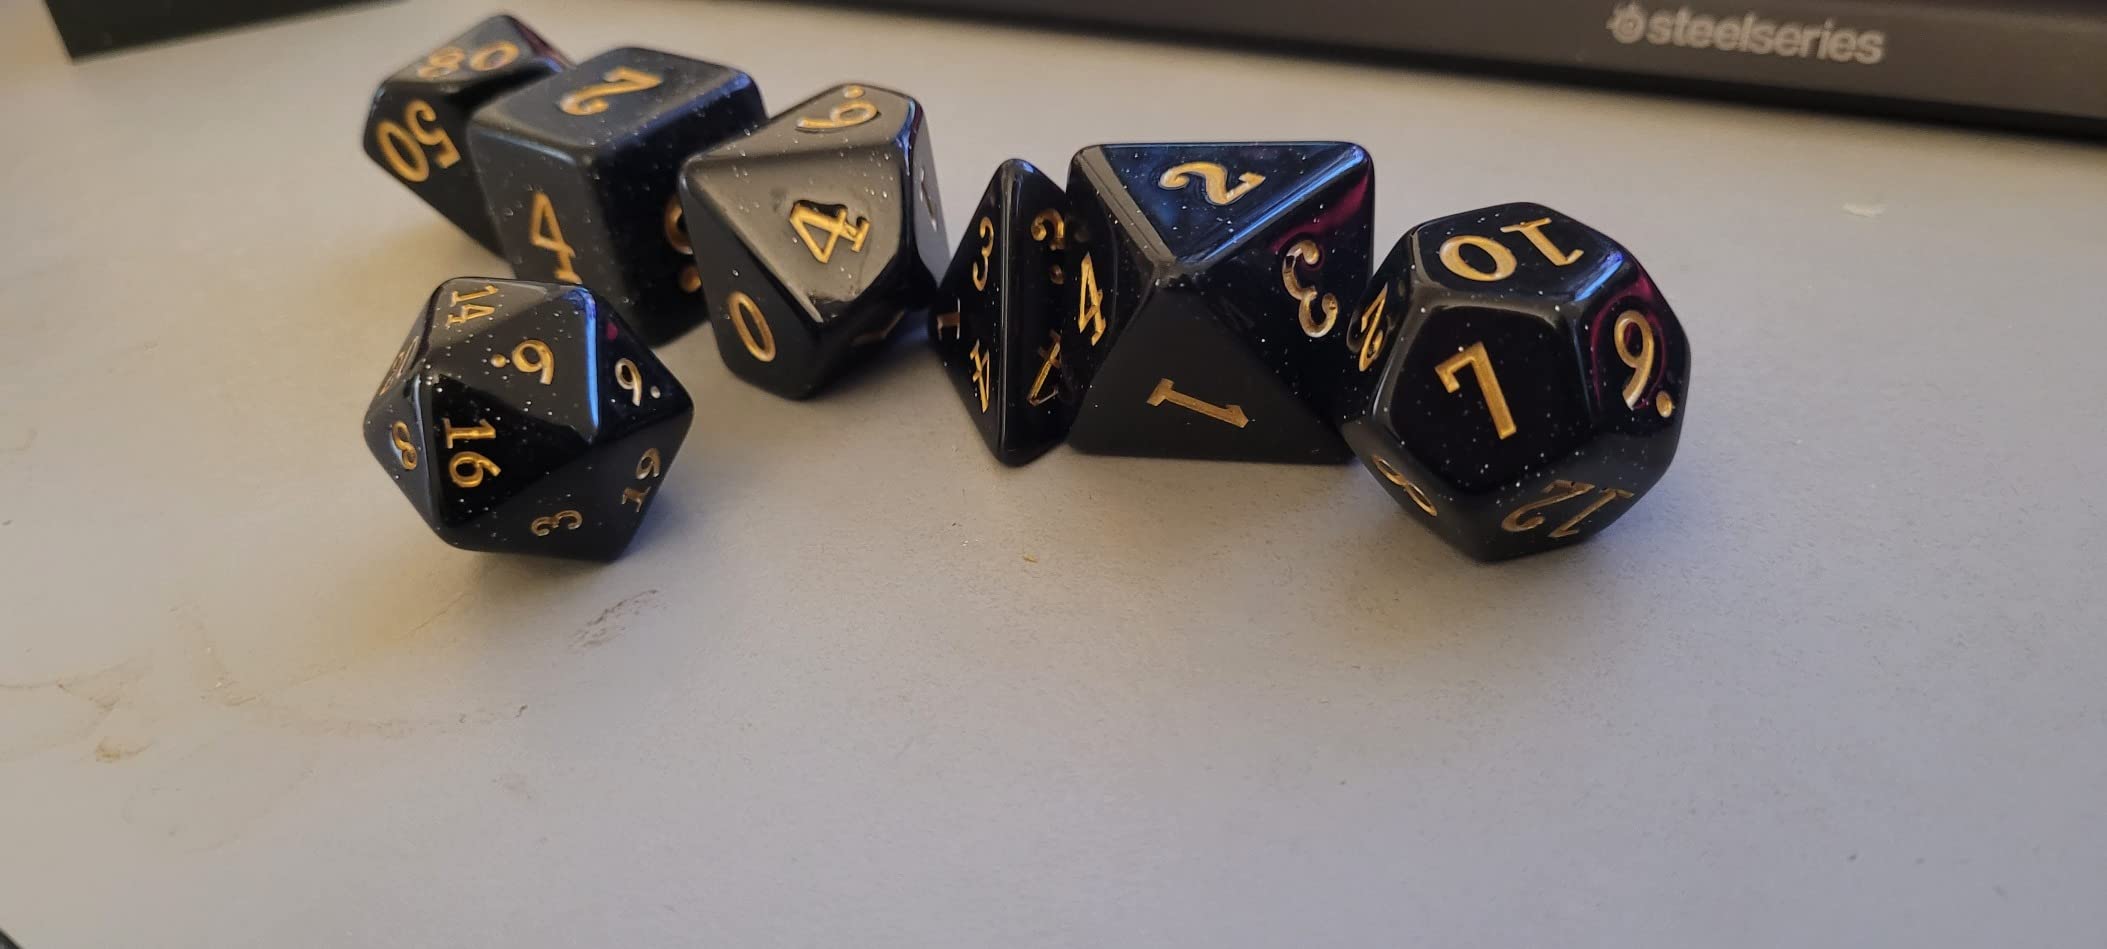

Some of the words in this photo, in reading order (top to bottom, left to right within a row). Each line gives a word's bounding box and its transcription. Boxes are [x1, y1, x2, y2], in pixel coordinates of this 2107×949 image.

[1646, 8, 1885, 65] steelseries
[556, 66, 663, 116] 2
[376, 99, 461, 182] 50
[1159, 162, 1266, 205] 2
[530, 191, 583, 284] 4
[789, 203, 870, 264] 4
[972, 216, 995, 292] 3
[1438, 217, 1585, 282] 10
[446, 285, 500, 327] 14
[1077, 252, 1107, 346] 4
[1281, 239, 1338, 338] 3
[728, 290, 777, 362] 0
[969, 337, 991, 413] 4
[1146, 378, 1249, 429] 1
[1433, 340, 1518, 440] 7
[441, 418, 502, 488] 16
[530, 509, 584, 537] 3
[1501, 479, 1635, 539] 12
